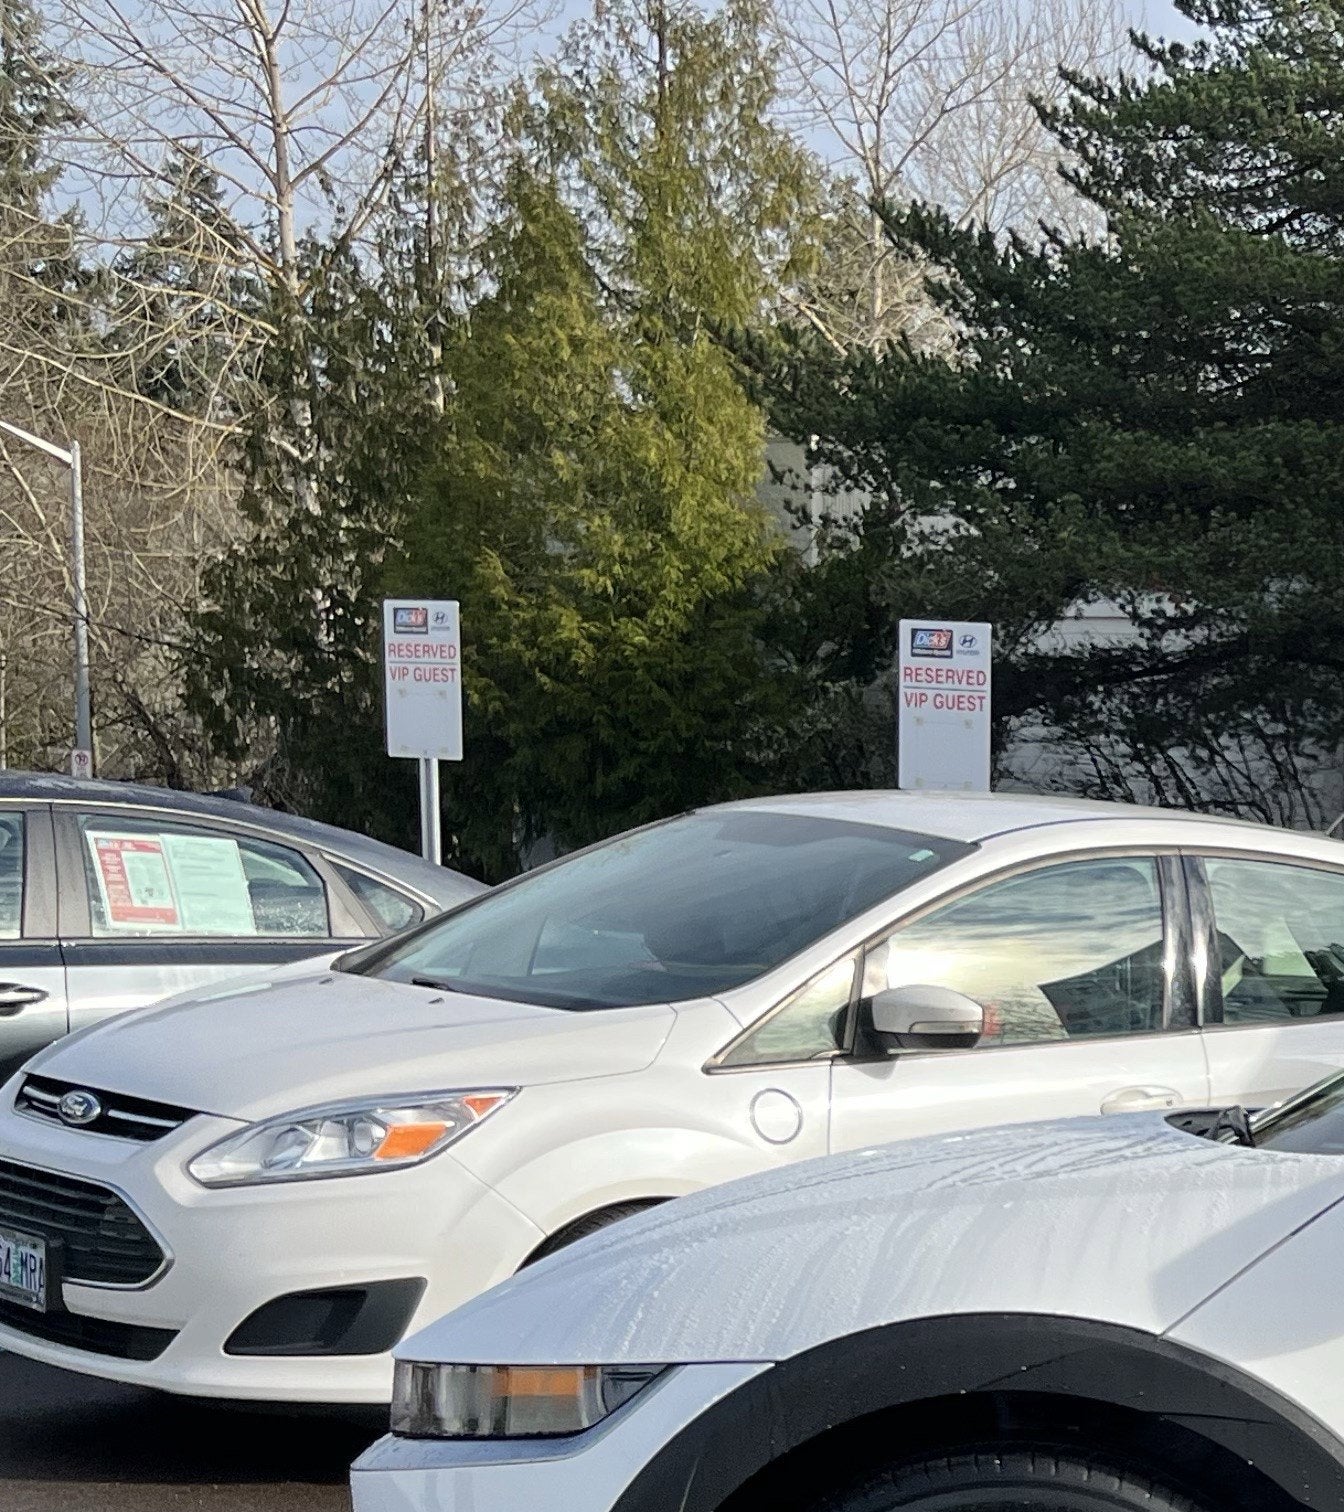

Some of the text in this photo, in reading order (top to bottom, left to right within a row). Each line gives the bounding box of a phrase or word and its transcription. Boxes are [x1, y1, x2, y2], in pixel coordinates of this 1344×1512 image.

[388, 643, 457, 660] RESERVED
[389, 666, 457, 683] VIP GUEST
[903, 667, 987, 686] RESERVED
[904, 692, 986, 711] VIP GUEST
